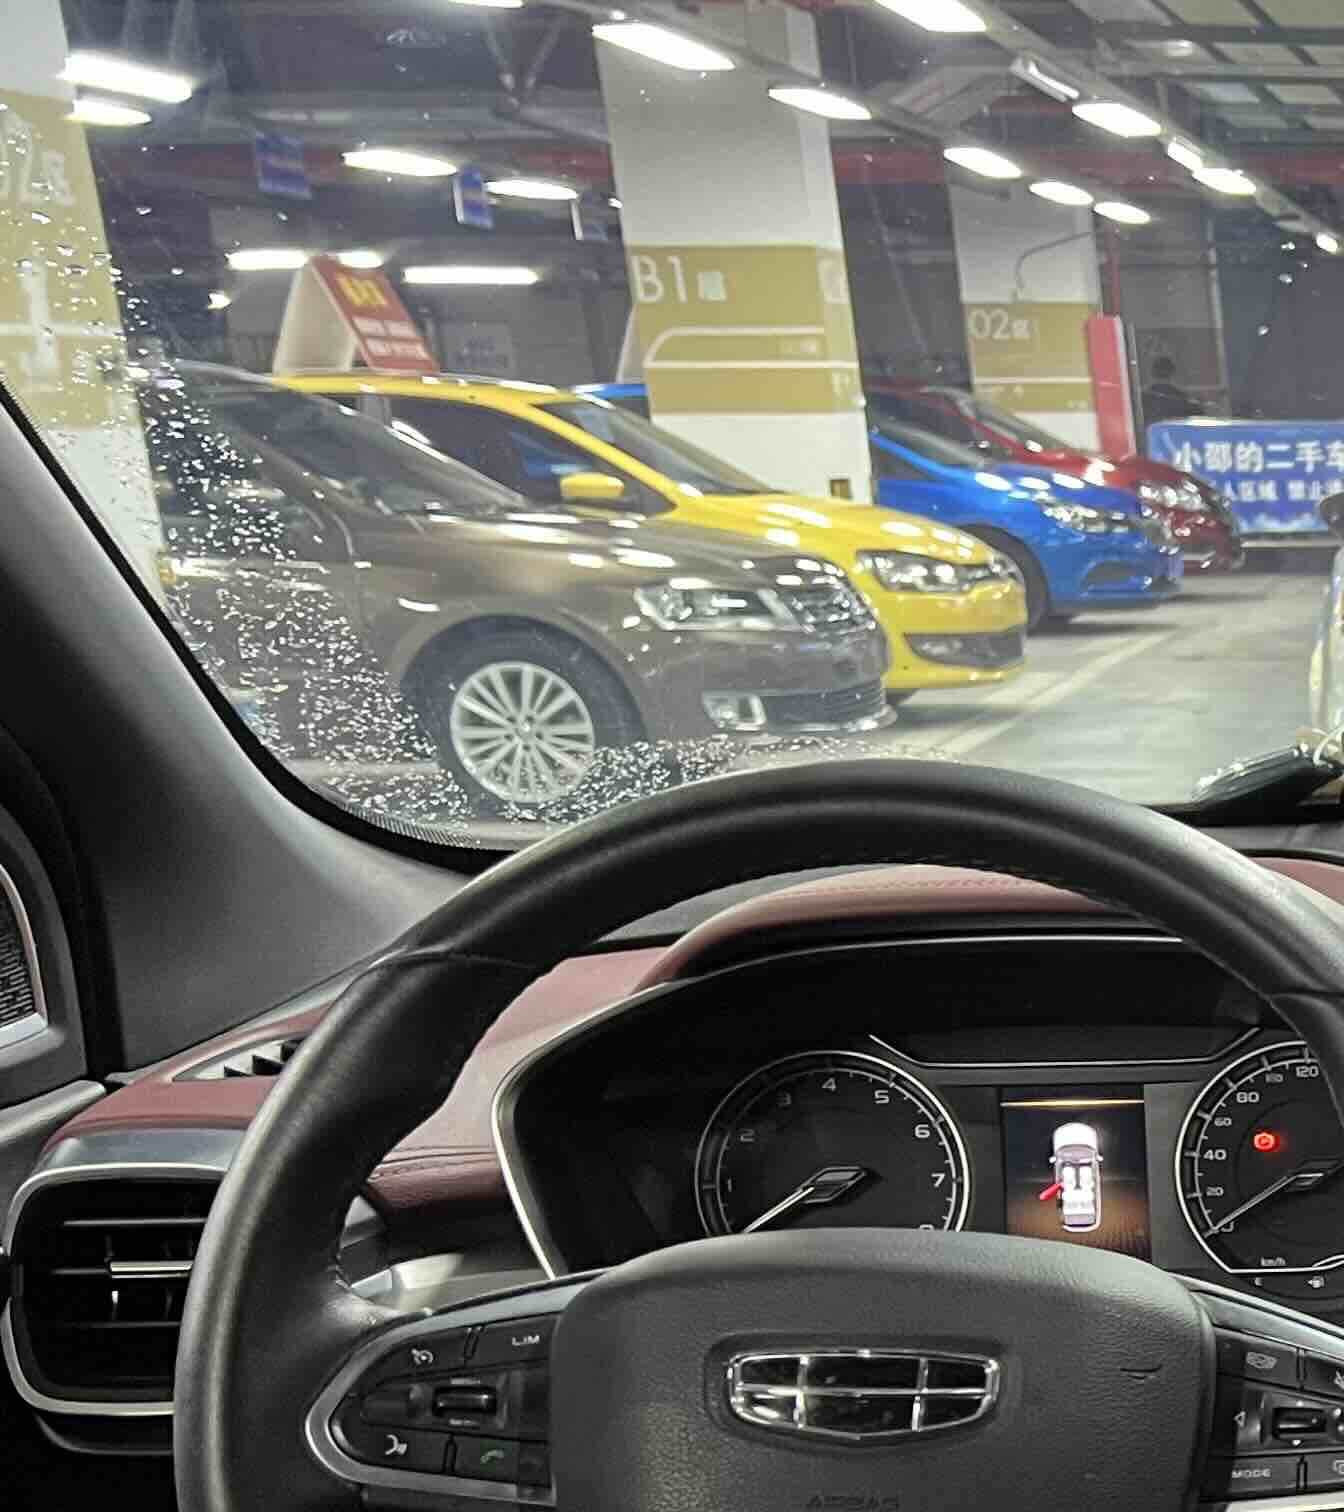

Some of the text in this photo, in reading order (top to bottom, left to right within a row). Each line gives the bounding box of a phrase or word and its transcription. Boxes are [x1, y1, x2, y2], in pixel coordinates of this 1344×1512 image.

[1296, 1065, 1319, 1078] 120
[821, 1077, 837, 1092] 4
[874, 1089, 890, 1104] 5
[1235, 1091, 1260, 1104] 80
[1214, 1116, 1233, 1127] 60
[740, 1128, 756, 1143] 2
[914, 1123, 931, 1139] 6
[1203, 1149, 1228, 1161] 40
[931, 1172, 946, 1188] 7
[1206, 1186, 1225, 1197] 20
[1260, 1256, 1287, 1266] km/h
[1231, 1467, 1272, 1479] MODE
